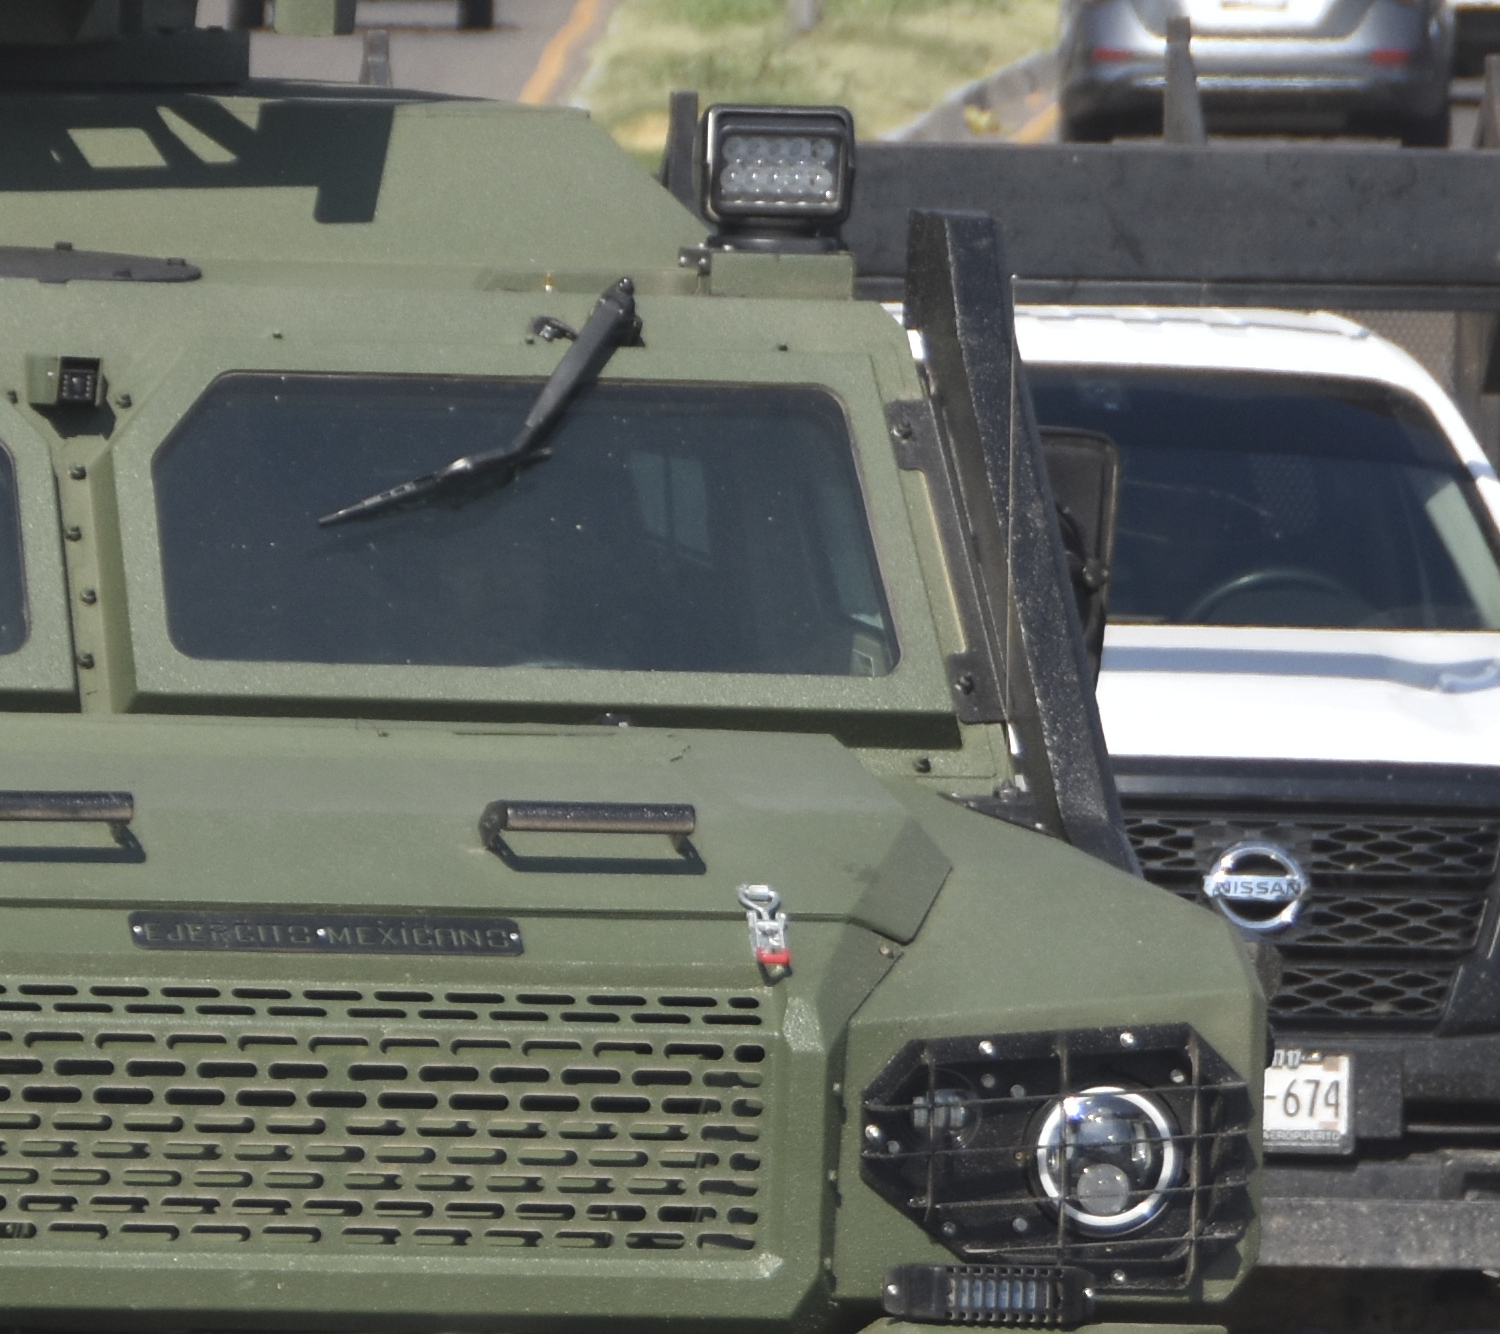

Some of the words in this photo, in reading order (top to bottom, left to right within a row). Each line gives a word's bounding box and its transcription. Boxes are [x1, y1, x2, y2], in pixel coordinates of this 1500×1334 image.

[1216, 880, 1300, 896] NISSAN
[142, 921, 313, 946] EJERCITO
[326, 924, 512, 949] MEXICANO
